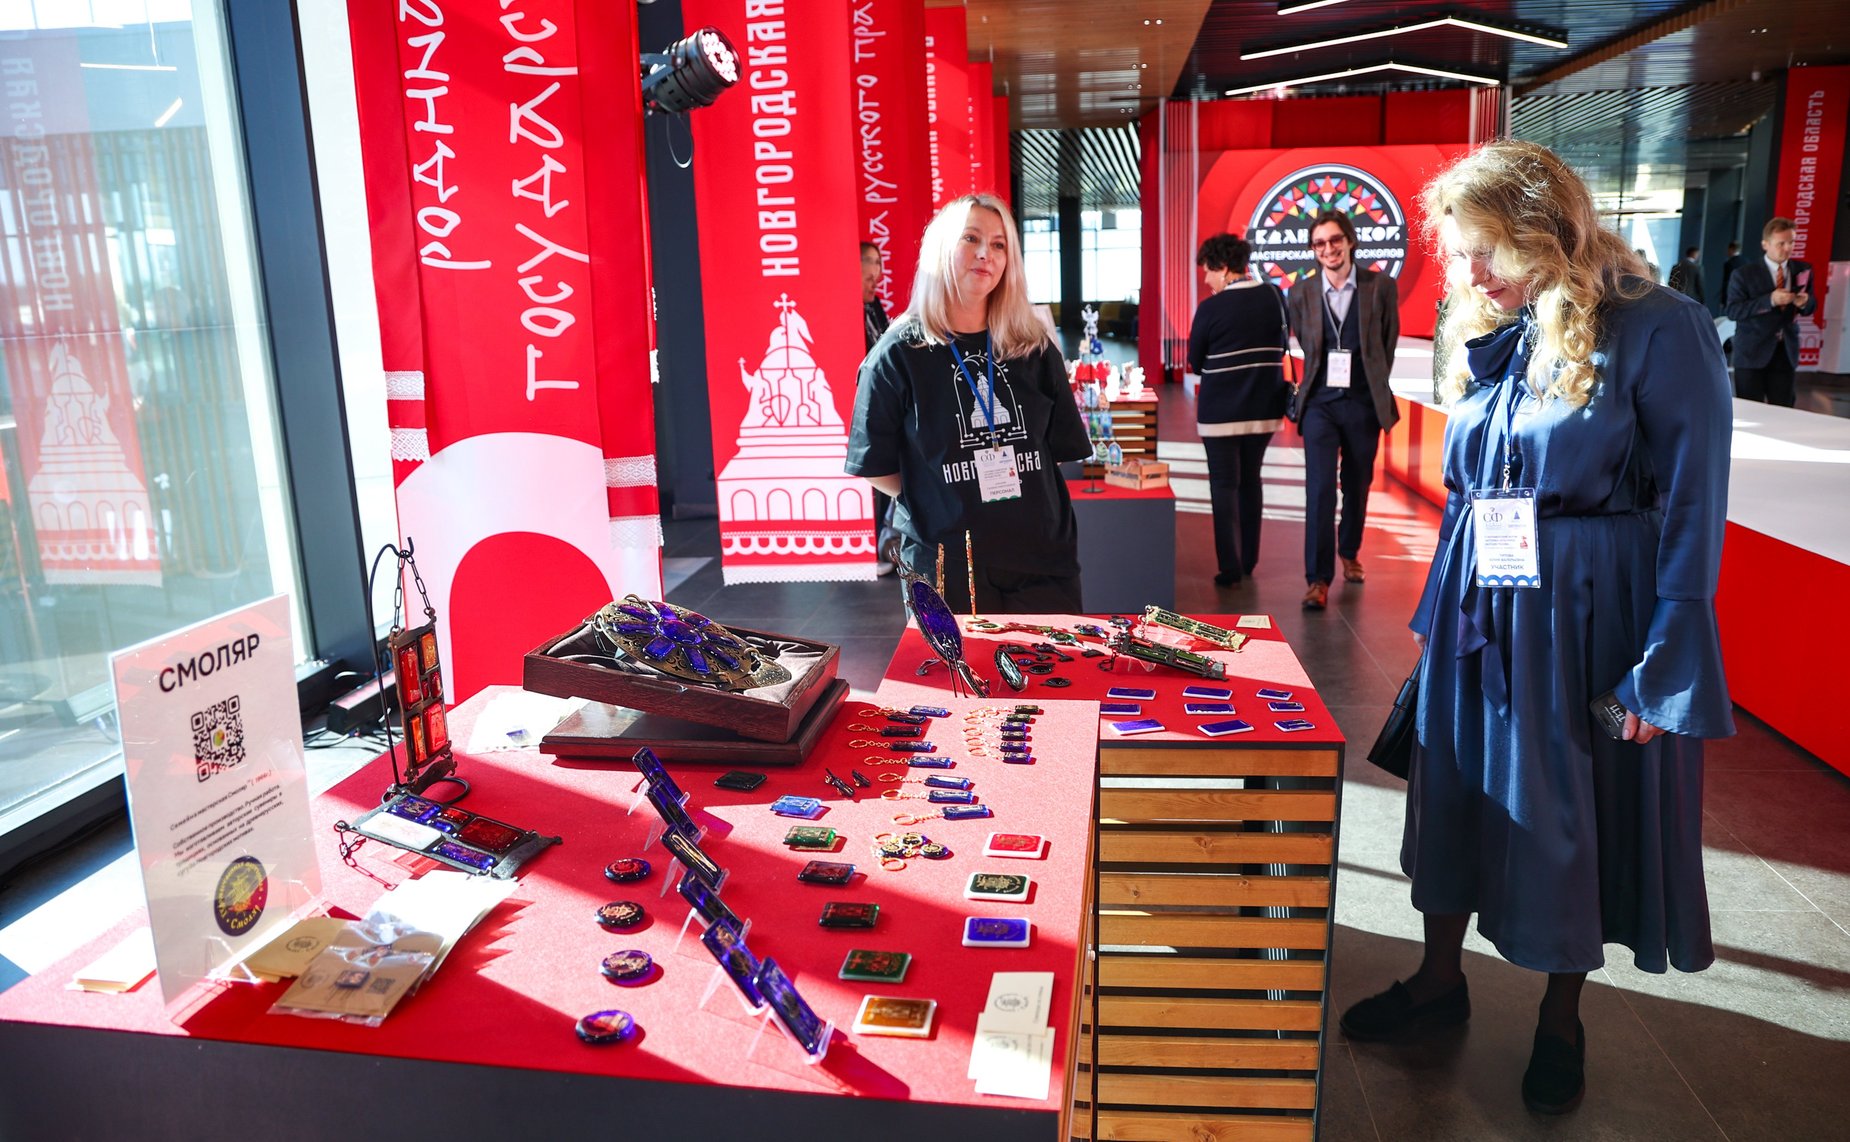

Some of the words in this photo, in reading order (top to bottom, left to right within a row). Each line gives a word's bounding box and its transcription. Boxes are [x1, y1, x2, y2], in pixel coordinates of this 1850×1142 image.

[499, 0, 590, 401] ГОСУДАРС
[745, 0, 800, 277] НОВГОРОДСКАЯ
[1803, 90, 1825, 153] ОБЛАСТЬ
[159, 634, 260, 693] СМОЛЯР
